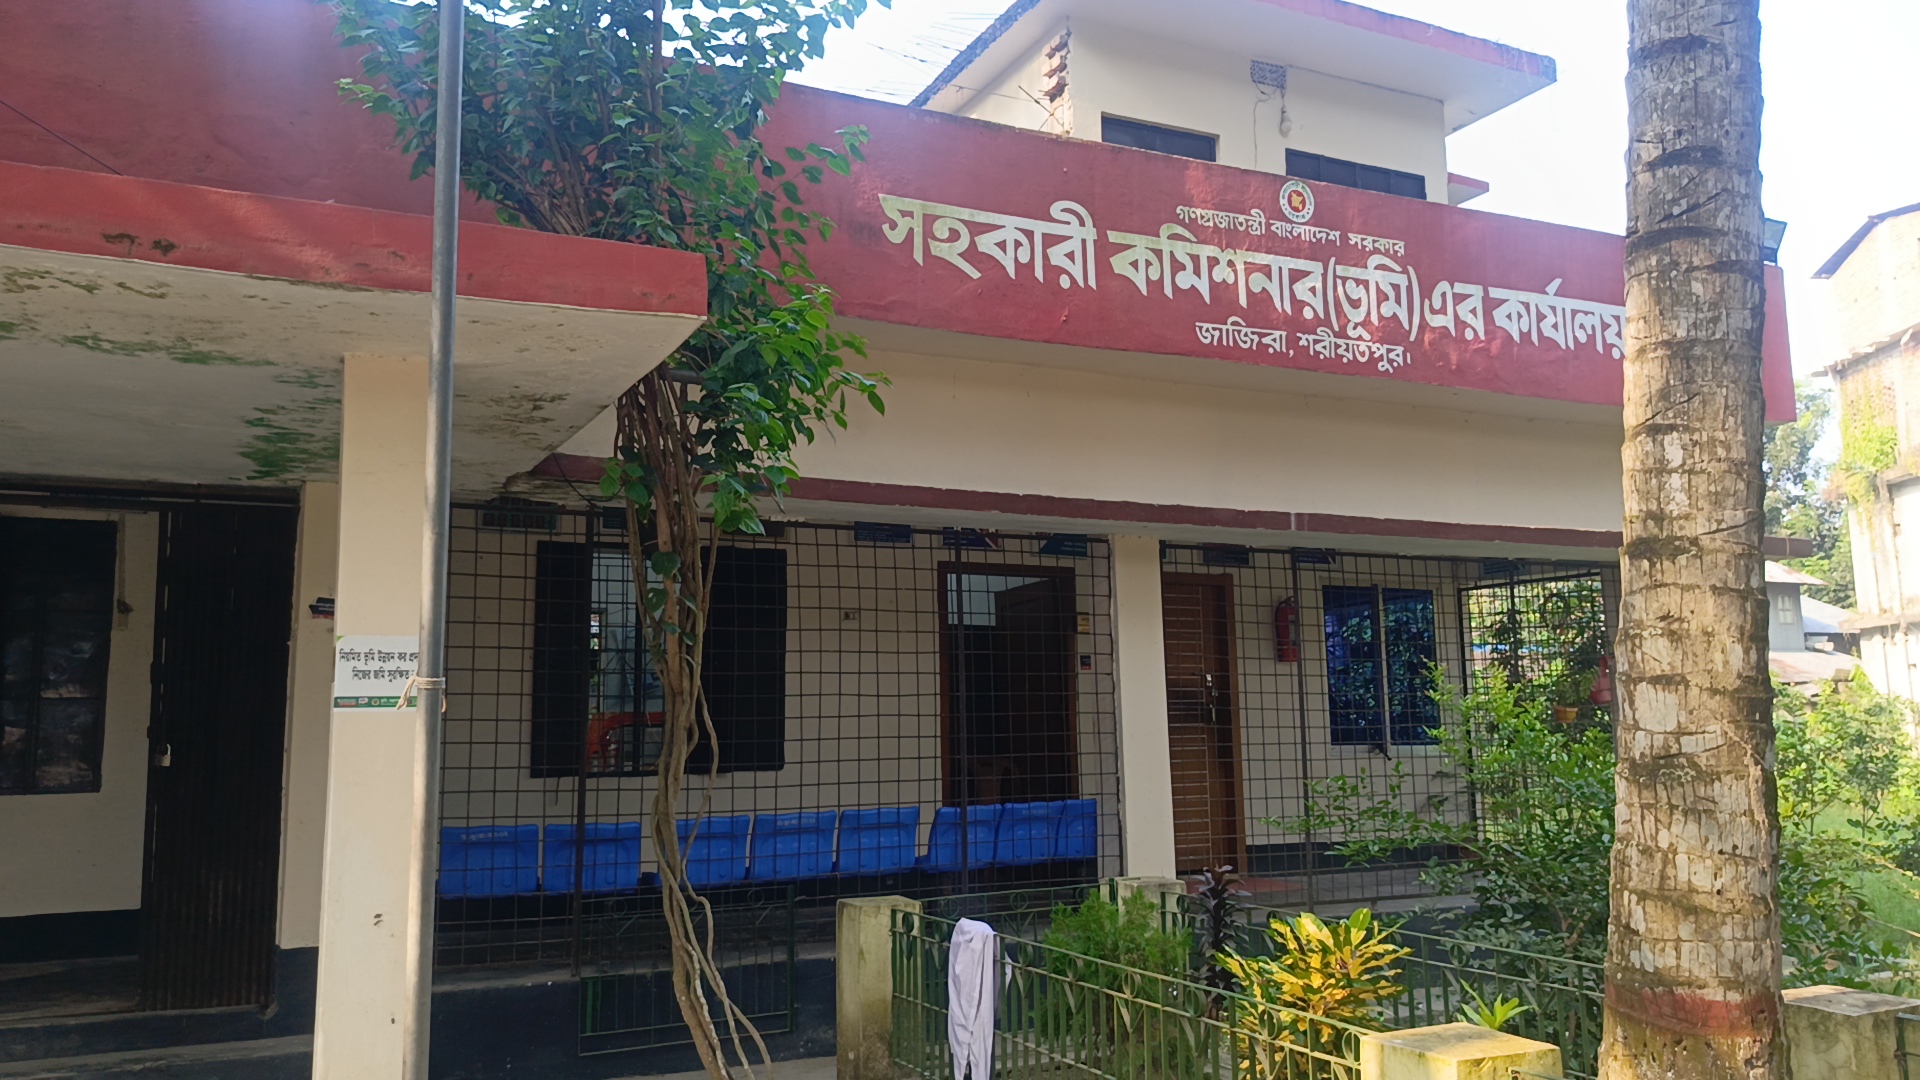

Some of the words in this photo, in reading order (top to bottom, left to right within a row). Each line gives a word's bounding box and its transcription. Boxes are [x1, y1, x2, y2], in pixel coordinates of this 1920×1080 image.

[1269, 219, 1341, 246] বাংলাদেশ
[1348, 232, 1405, 256] সরকার
[878, 193, 1098, 290] সহকারী
[1424, 280, 1485, 341] এর
[1488, 278, 1627, 359] কার্যালয়
[1195, 316, 1294, 358] জাজিরা,
[1297, 327, 1411, 373] শরীয়তপুর।
